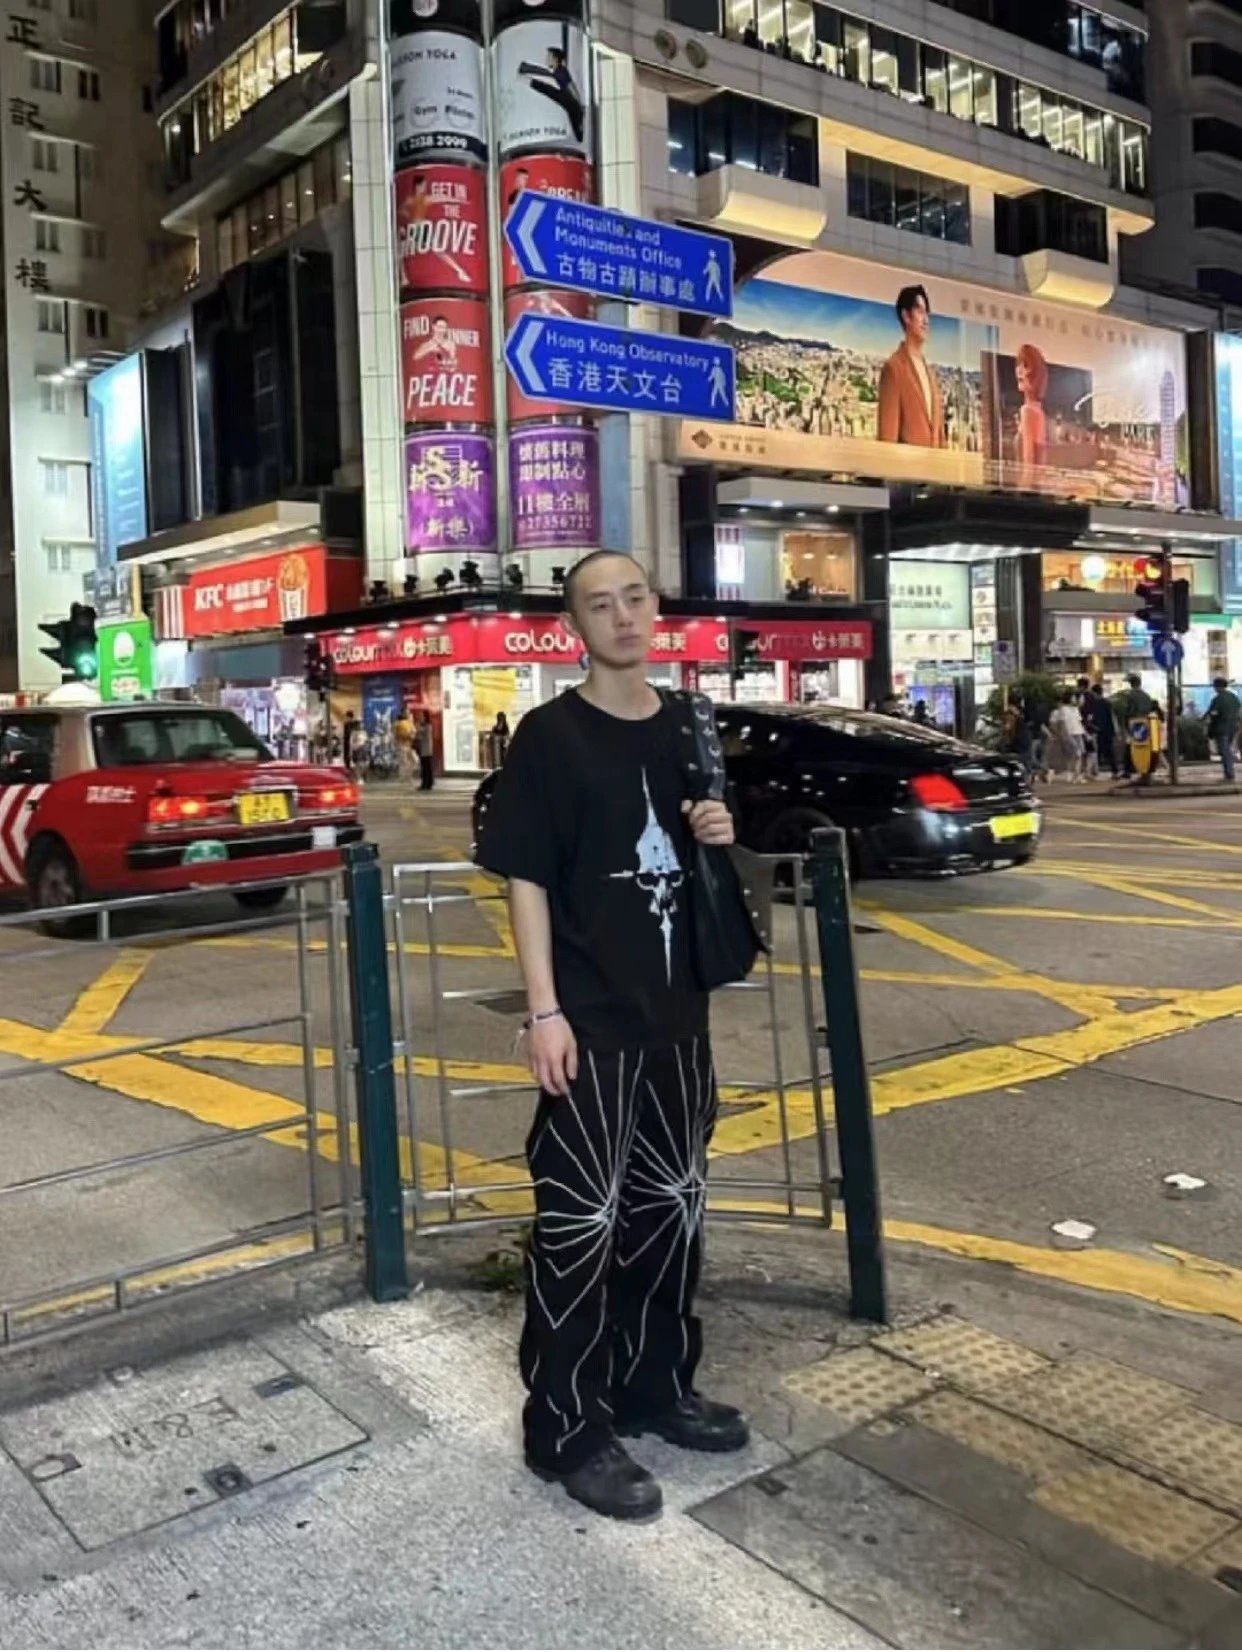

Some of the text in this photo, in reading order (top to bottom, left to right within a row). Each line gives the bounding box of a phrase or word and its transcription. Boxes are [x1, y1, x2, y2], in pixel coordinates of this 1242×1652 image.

[555, 226, 682, 270] Monuments Office
[635, 229, 661, 246] and
[546, 330, 709, 373] Hong Kong Observatory
[407, 373, 478, 409] PEACE
[547, 357, 683, 404] 香港天文台
[195, 584, 224, 611] KFC
